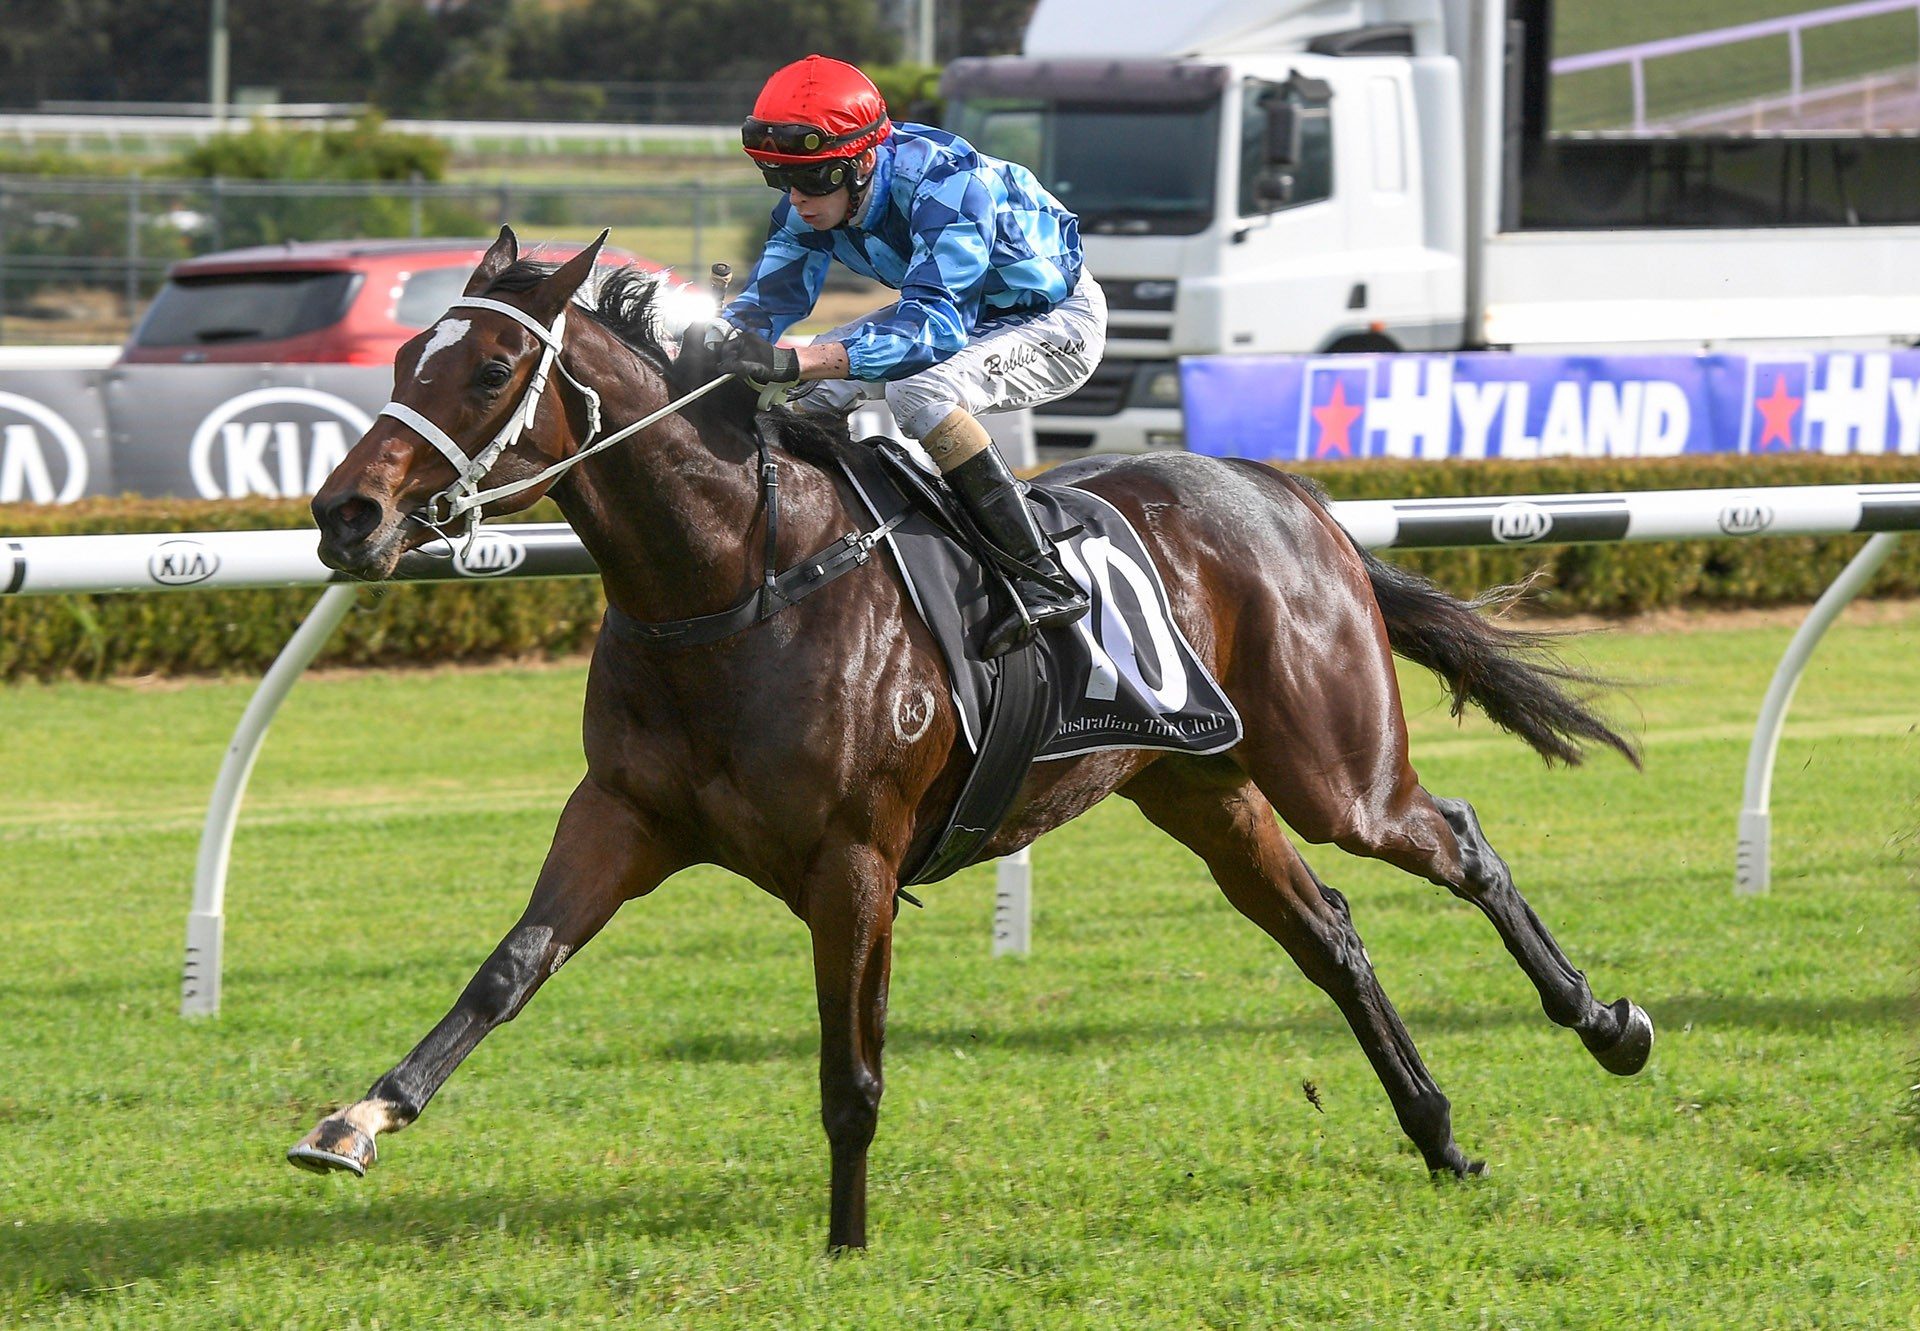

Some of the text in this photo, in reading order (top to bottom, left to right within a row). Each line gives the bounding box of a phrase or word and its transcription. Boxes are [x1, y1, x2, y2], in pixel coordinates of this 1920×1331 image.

[984, 343, 1038, 381] Robbie
[1368, 358, 1692, 459] HYLAND
[221, 421, 350, 500] KIA
[1727, 506, 1763, 528] KIA
[160, 552, 206, 577] KIA
[463, 542, 514, 569] KIA
[1055, 536, 1187, 714] 10
[1178, 712, 1226, 736] Club
